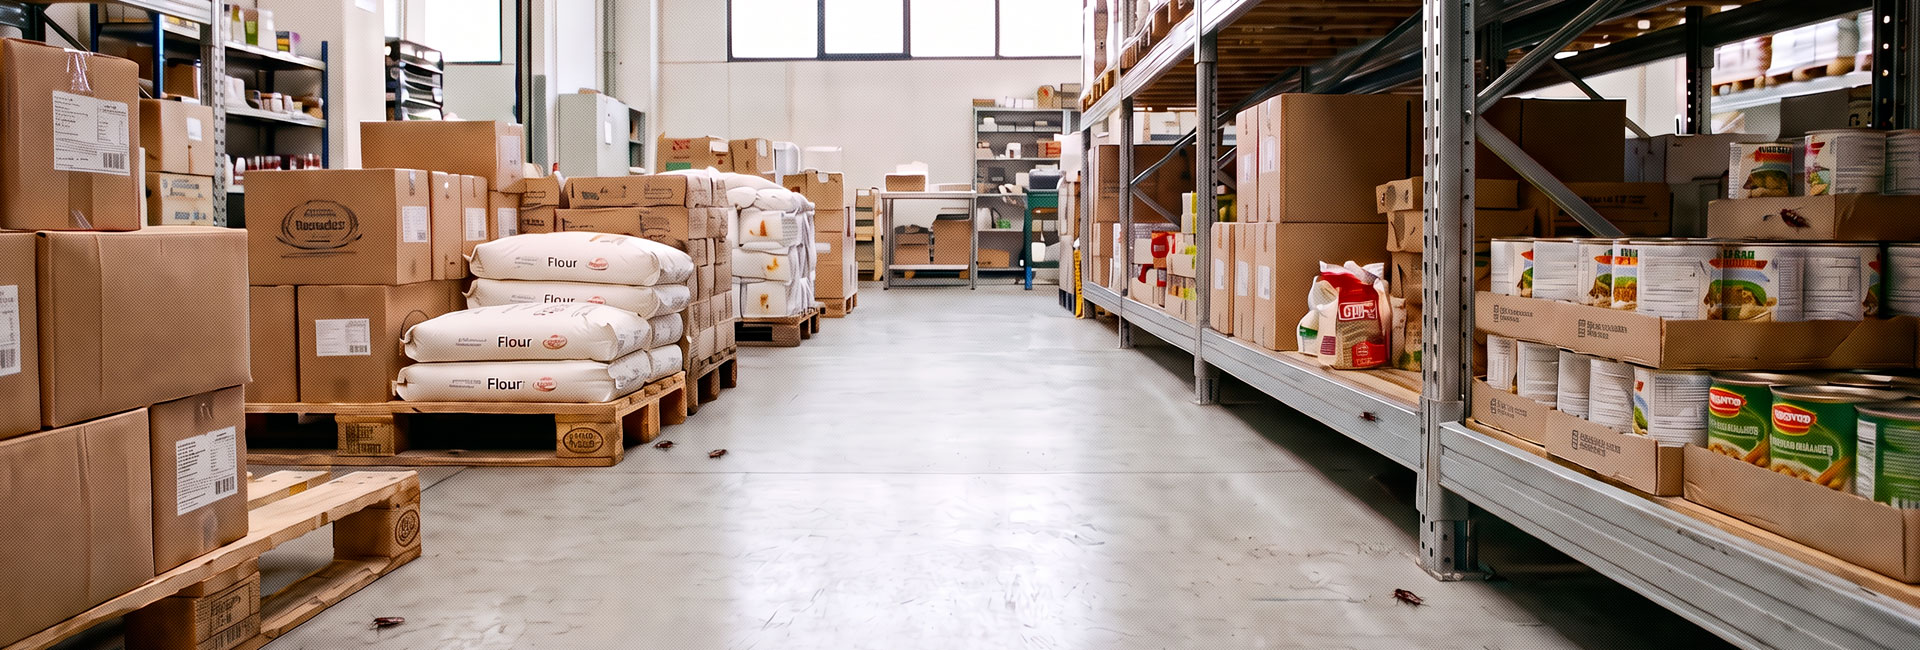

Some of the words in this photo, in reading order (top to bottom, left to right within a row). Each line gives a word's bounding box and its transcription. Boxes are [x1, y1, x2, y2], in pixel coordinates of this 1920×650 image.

[547, 257, 578, 268] Flour
[497, 336, 532, 348] Flour
[487, 378, 522, 390] Flour
